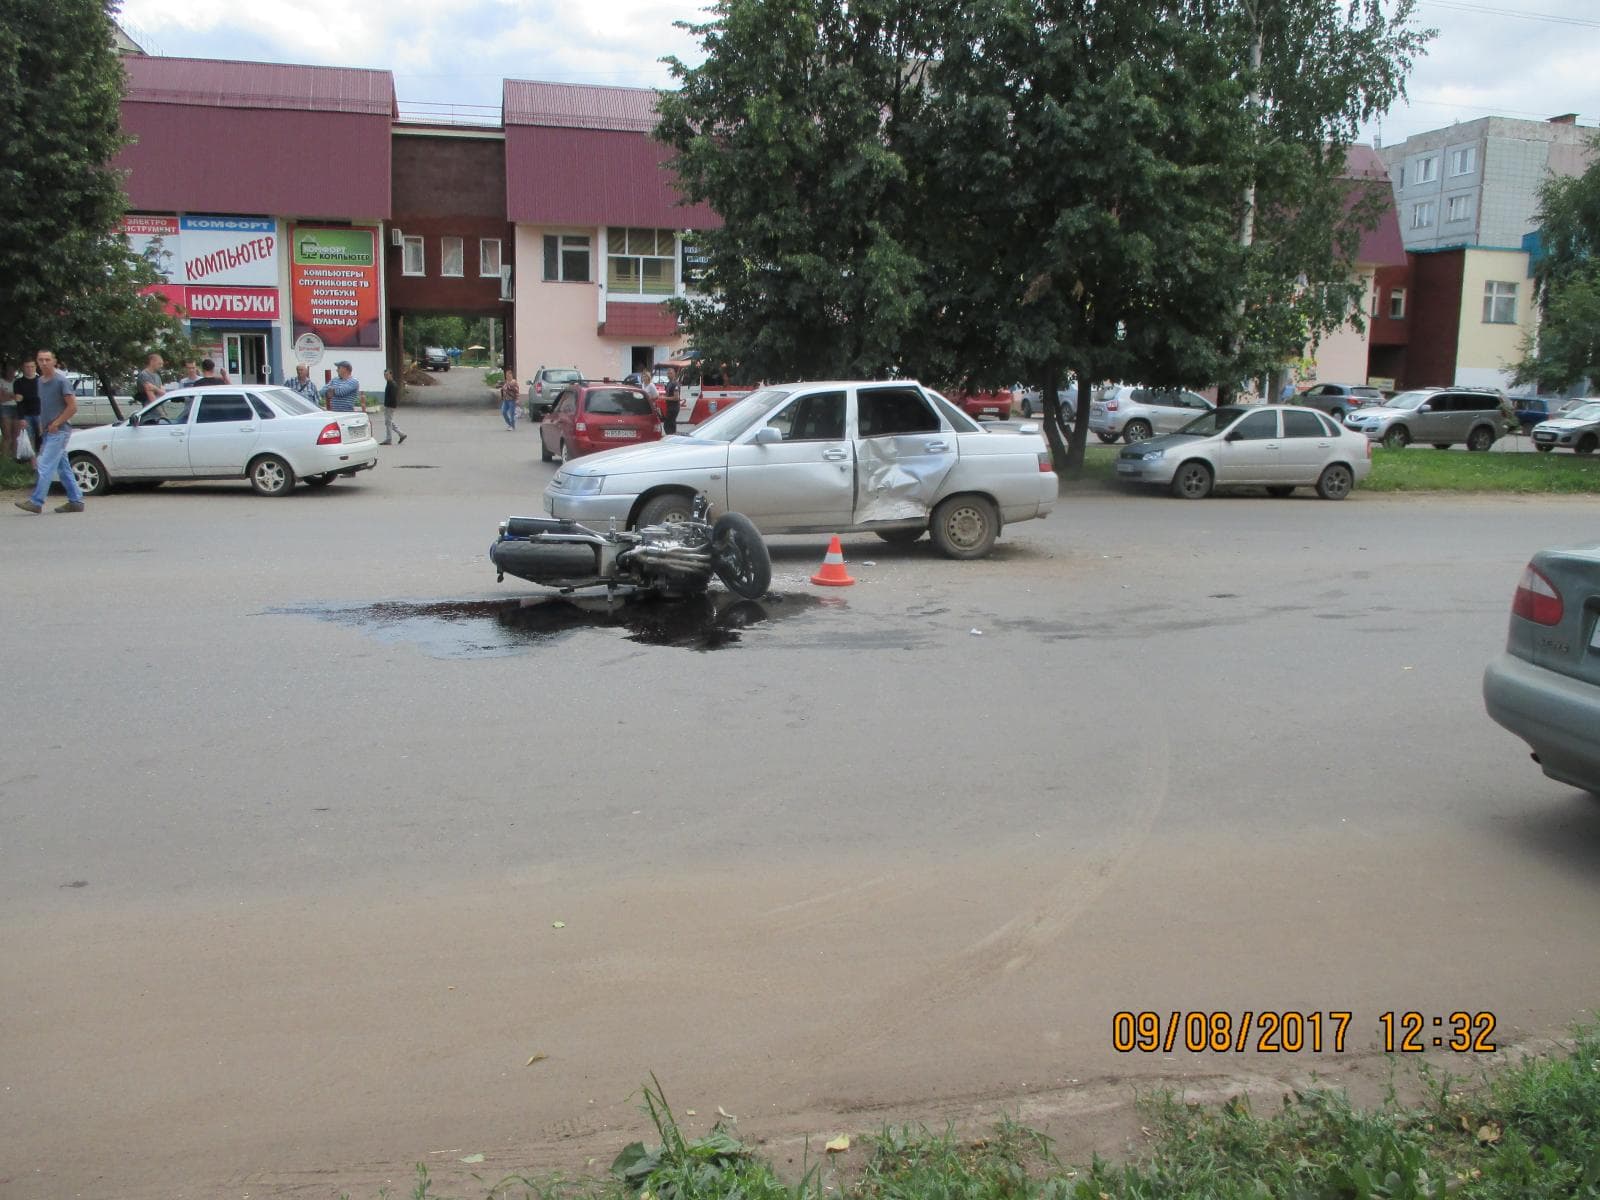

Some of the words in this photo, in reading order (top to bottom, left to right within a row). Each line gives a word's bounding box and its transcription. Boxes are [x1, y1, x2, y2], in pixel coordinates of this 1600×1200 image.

[187, 219, 270, 230] КОМФОРТ
[185, 236, 275, 281] КОМПЬЮТЕР
[319, 253, 370, 261] КОМПЬЮТЕР
[303, 269, 364, 278] КОМПЬЮТЕРЫ
[298, 278, 358, 287] СПУТНИКОВОЕ
[313, 288, 356, 297] НОУТБУКИ
[191, 294, 275, 312] НОУТБУКИ
[310, 298, 359, 307] МОНИТОРЫ
[312, 308, 358, 316] ПРИНТЕРЫ
[312, 317, 346, 326] ПУЛЬТЫ
